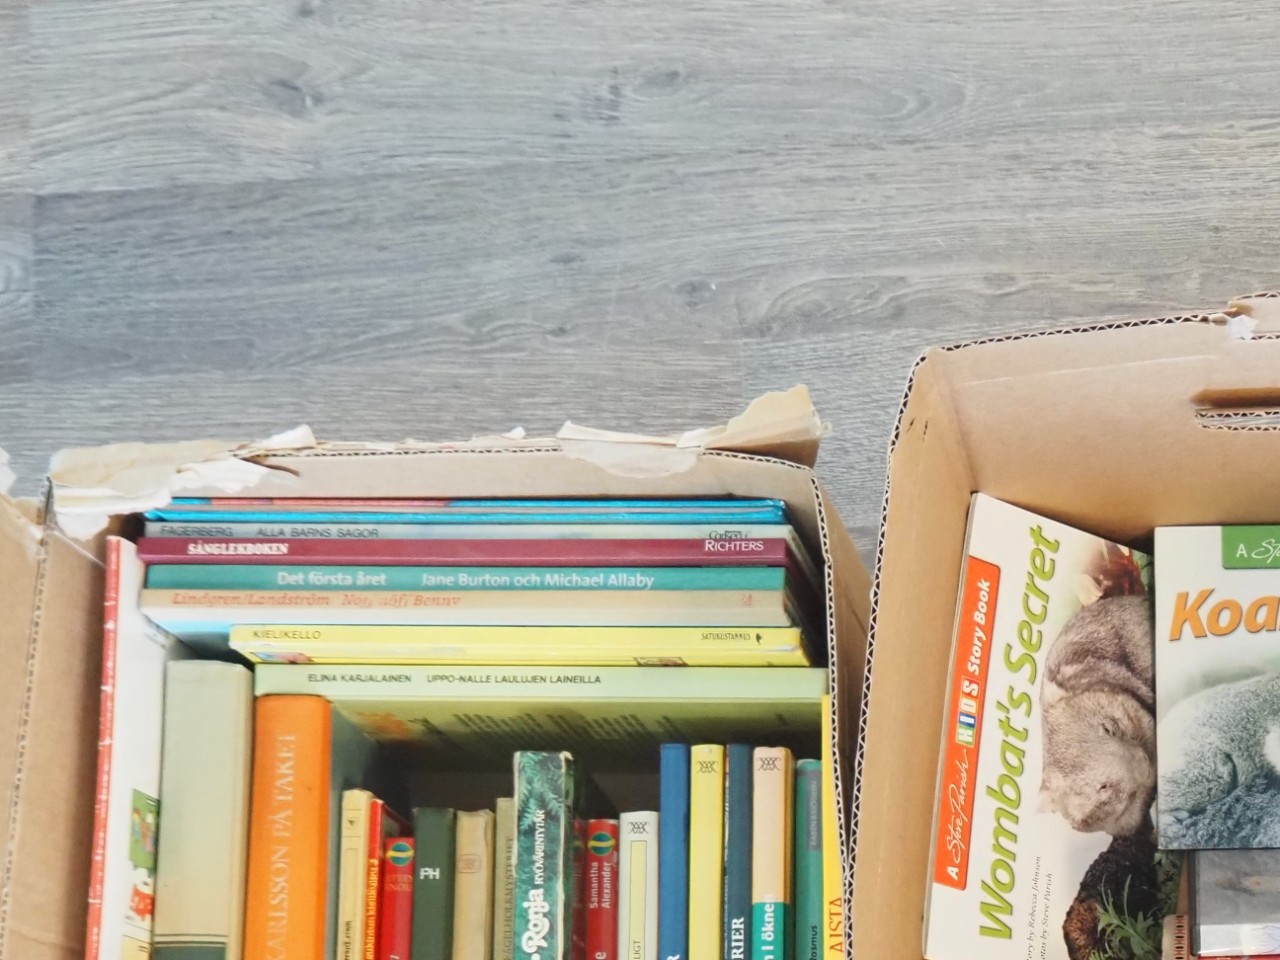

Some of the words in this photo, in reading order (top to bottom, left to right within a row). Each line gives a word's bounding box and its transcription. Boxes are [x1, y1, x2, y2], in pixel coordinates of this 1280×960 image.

[160, 526, 233, 538] FAGERBERG
[256, 527, 286, 538] ALLA
[290, 527, 332, 538] BARNS
[337, 527, 379, 539] SAGOR
[1236, 543, 1247, 558] A
[277, 572, 305, 585] Det
[308, 571, 352, 586] första
[357, 571, 387, 586] året
[421, 572, 458, 587] Jane
[461, 572, 510, 587] Burton
[514, 573, 541, 587] och
[545, 572, 604, 587] Michael
[608, 573, 655, 590] Allaby
[973, 578, 991, 626] Book
[1003, 525, 1061, 686] Secret
[253, 630, 321, 640] KIELIKELLO
[967, 625, 987, 676] Story
[308, 673, 338, 684] ELINA
[340, 674, 411, 684] KARJALAINEN
[426, 674, 492, 685] UPPO-NALLE
[494, 675, 547, 685] LAULUJEN
[550, 675, 601, 685] LAINEILLA
[957, 678, 980, 745] KIDS
[979, 686, 1032, 940] Wombat's
[589, 862, 599, 908] Samantha
[601, 861, 611, 908] Alexander
[945, 867, 959, 881] A
[522, 888, 549, 953] Ronja
[761, 894, 775, 941] öknen
